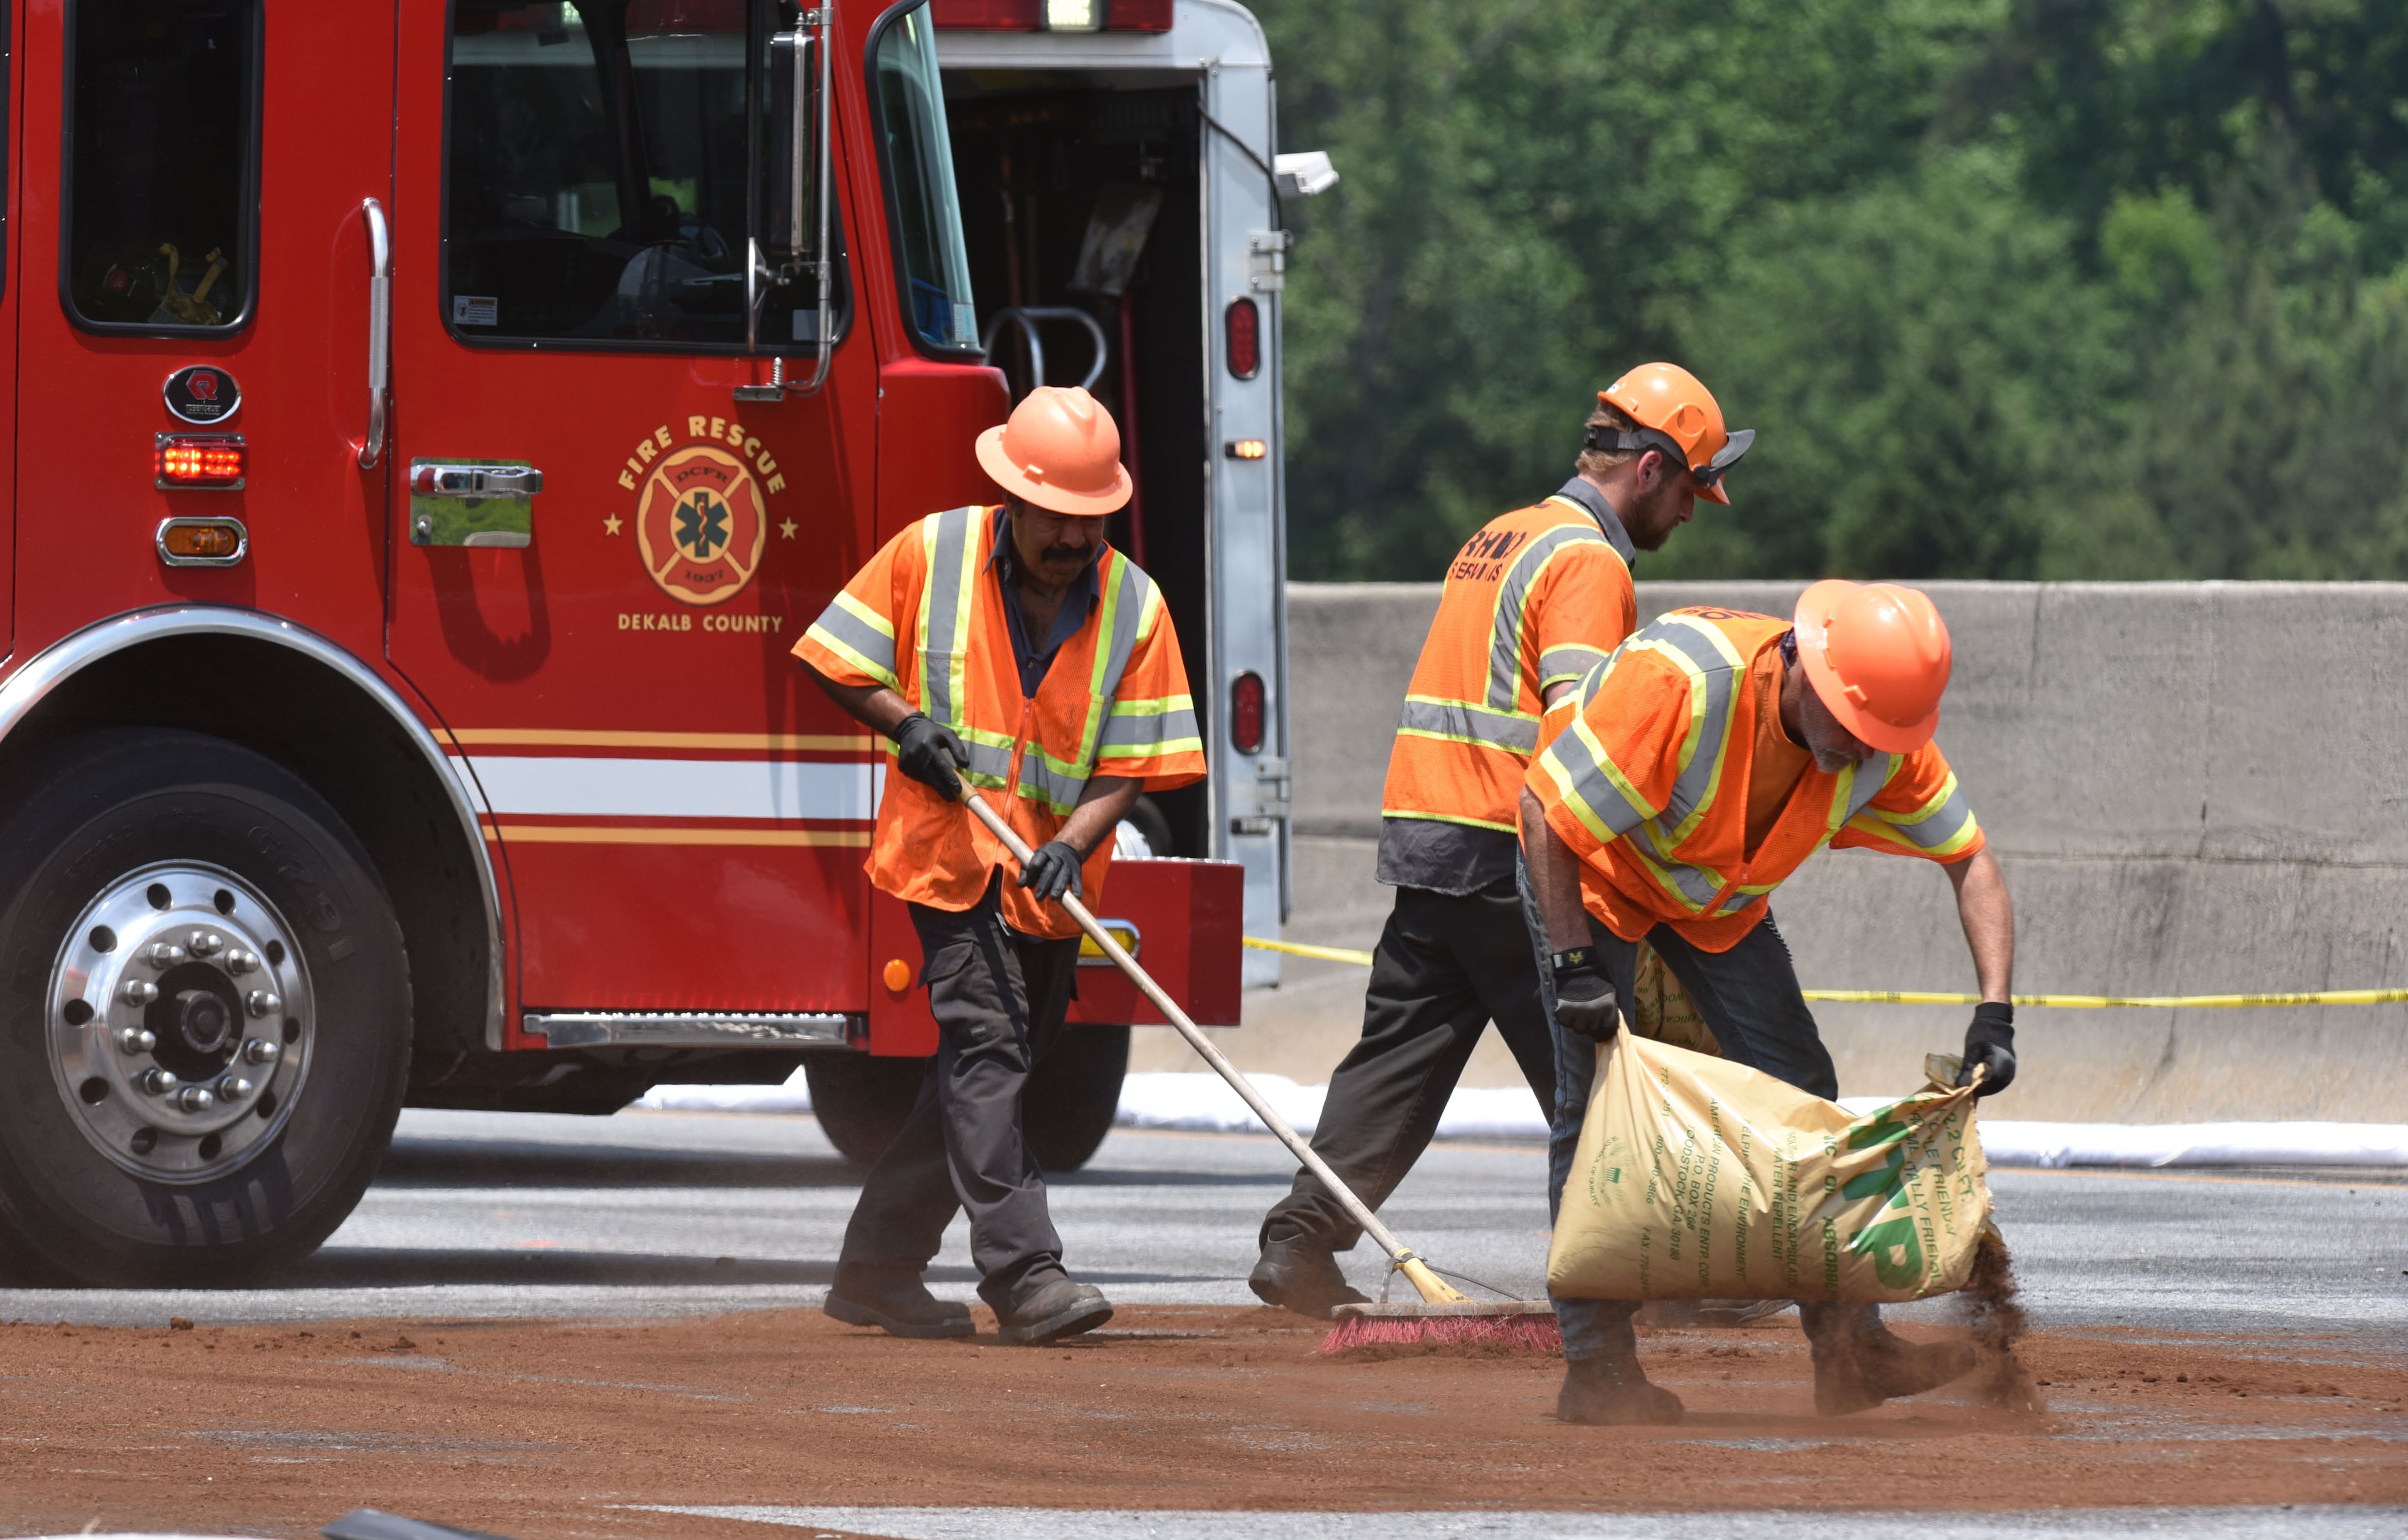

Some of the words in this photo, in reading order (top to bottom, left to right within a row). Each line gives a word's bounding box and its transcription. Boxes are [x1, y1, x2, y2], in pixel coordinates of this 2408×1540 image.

[618, 425, 673, 491] FIRE
[688, 415, 786, 494] RESCUE
[676, 466, 729, 483] DCFR
[684, 569, 725, 583] 1937
[618, 613, 692, 631] DEKALB
[702, 614, 783, 633] COUNTY
[1943, 1113, 1960, 1141] 2.2
[1693, 1154, 1706, 1175] P.O.
[1689, 1179, 1701, 1208] BOX
[1700, 1156, 1719, 1225] PRODUCTS
[1787, 1176, 1797, 1205] AND
[1735, 1198, 1750, 1279] ENVIRONMENT
[1772, 1192, 1784, 1260] REPELLENT
